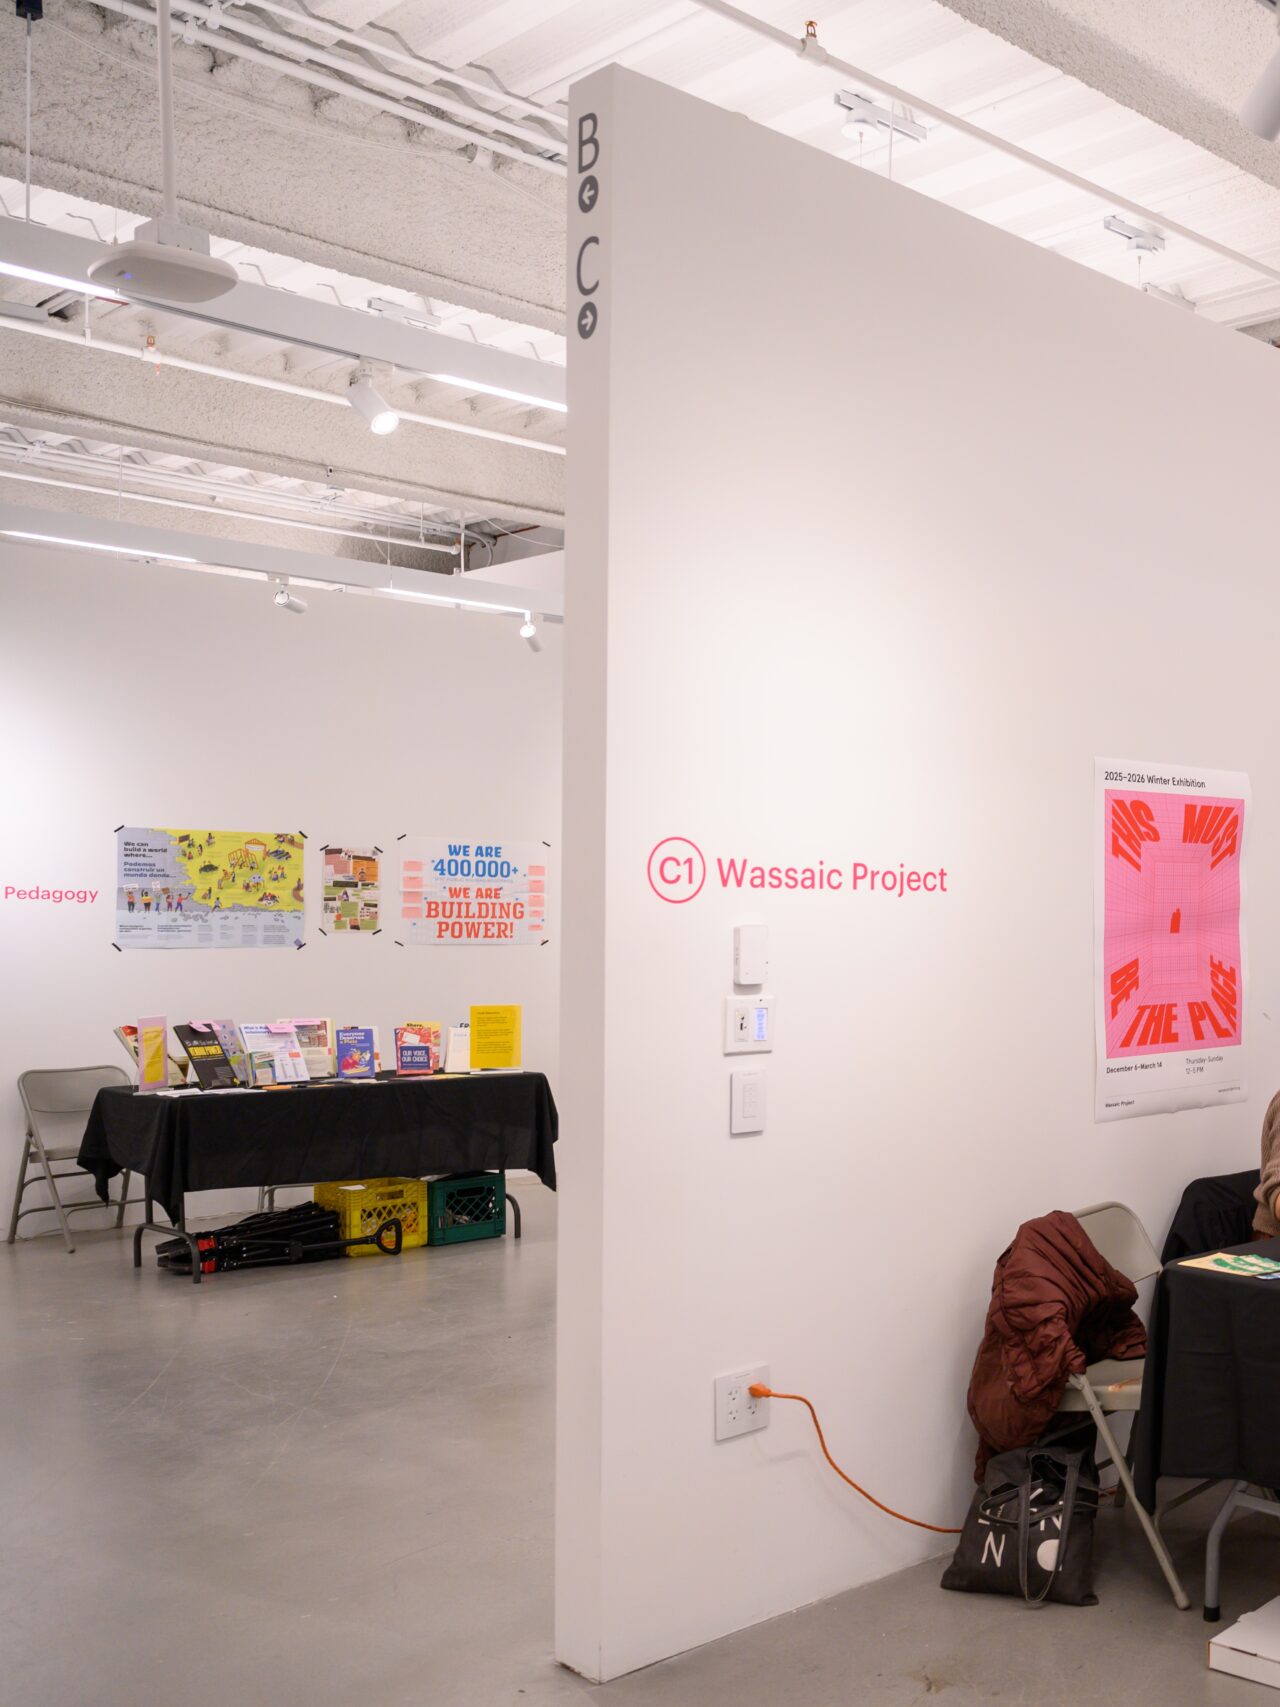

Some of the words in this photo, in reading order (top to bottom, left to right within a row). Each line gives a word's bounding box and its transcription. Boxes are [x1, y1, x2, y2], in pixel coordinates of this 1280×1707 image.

[577, 112, 600, 174] B
[576, 235, 600, 296] C
[1146, 774, 1170, 786] Winter
[1171, 777, 1206, 788] Exhibition
[1182, 803, 1239, 871] MUST
[448, 844, 470, 857] WE
[474, 846, 502, 858] ARE
[433, 858, 519, 878] 400,000+
[659, 856, 694, 885] C1
[716, 857, 843, 890] Wassaic
[852, 862, 948, 898] Project
[4, 886, 99, 904] Pedagogy
[448, 887, 470, 899] WE
[475, 887, 502, 900] ARE
[425, 901, 525, 919] BUILDING
[436, 921, 515, 939] POWER!
[1118, 1002, 1179, 1048] THE
[1106, 1065, 1133, 1074] December
